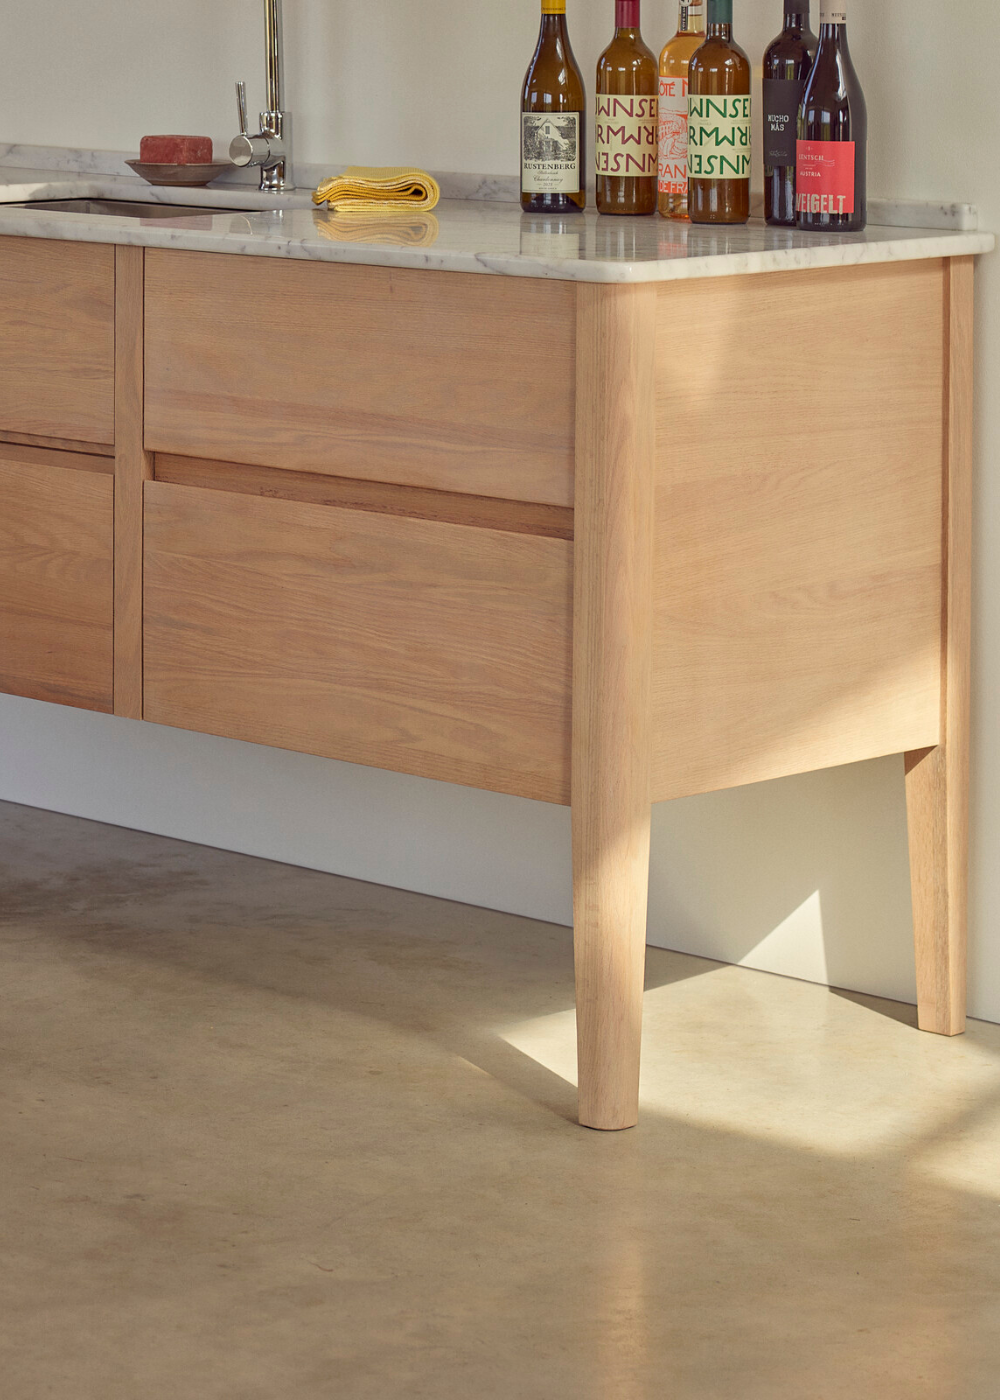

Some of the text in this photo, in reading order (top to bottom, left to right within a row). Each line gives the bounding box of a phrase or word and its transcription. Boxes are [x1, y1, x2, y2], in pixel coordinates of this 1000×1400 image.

[658, 79, 676, 97] ÔTÉ
[767, 114, 790, 123] MUCHO
[523, 162, 576, 170] RUSTENBERG
[658, 162, 687, 179] RAN
